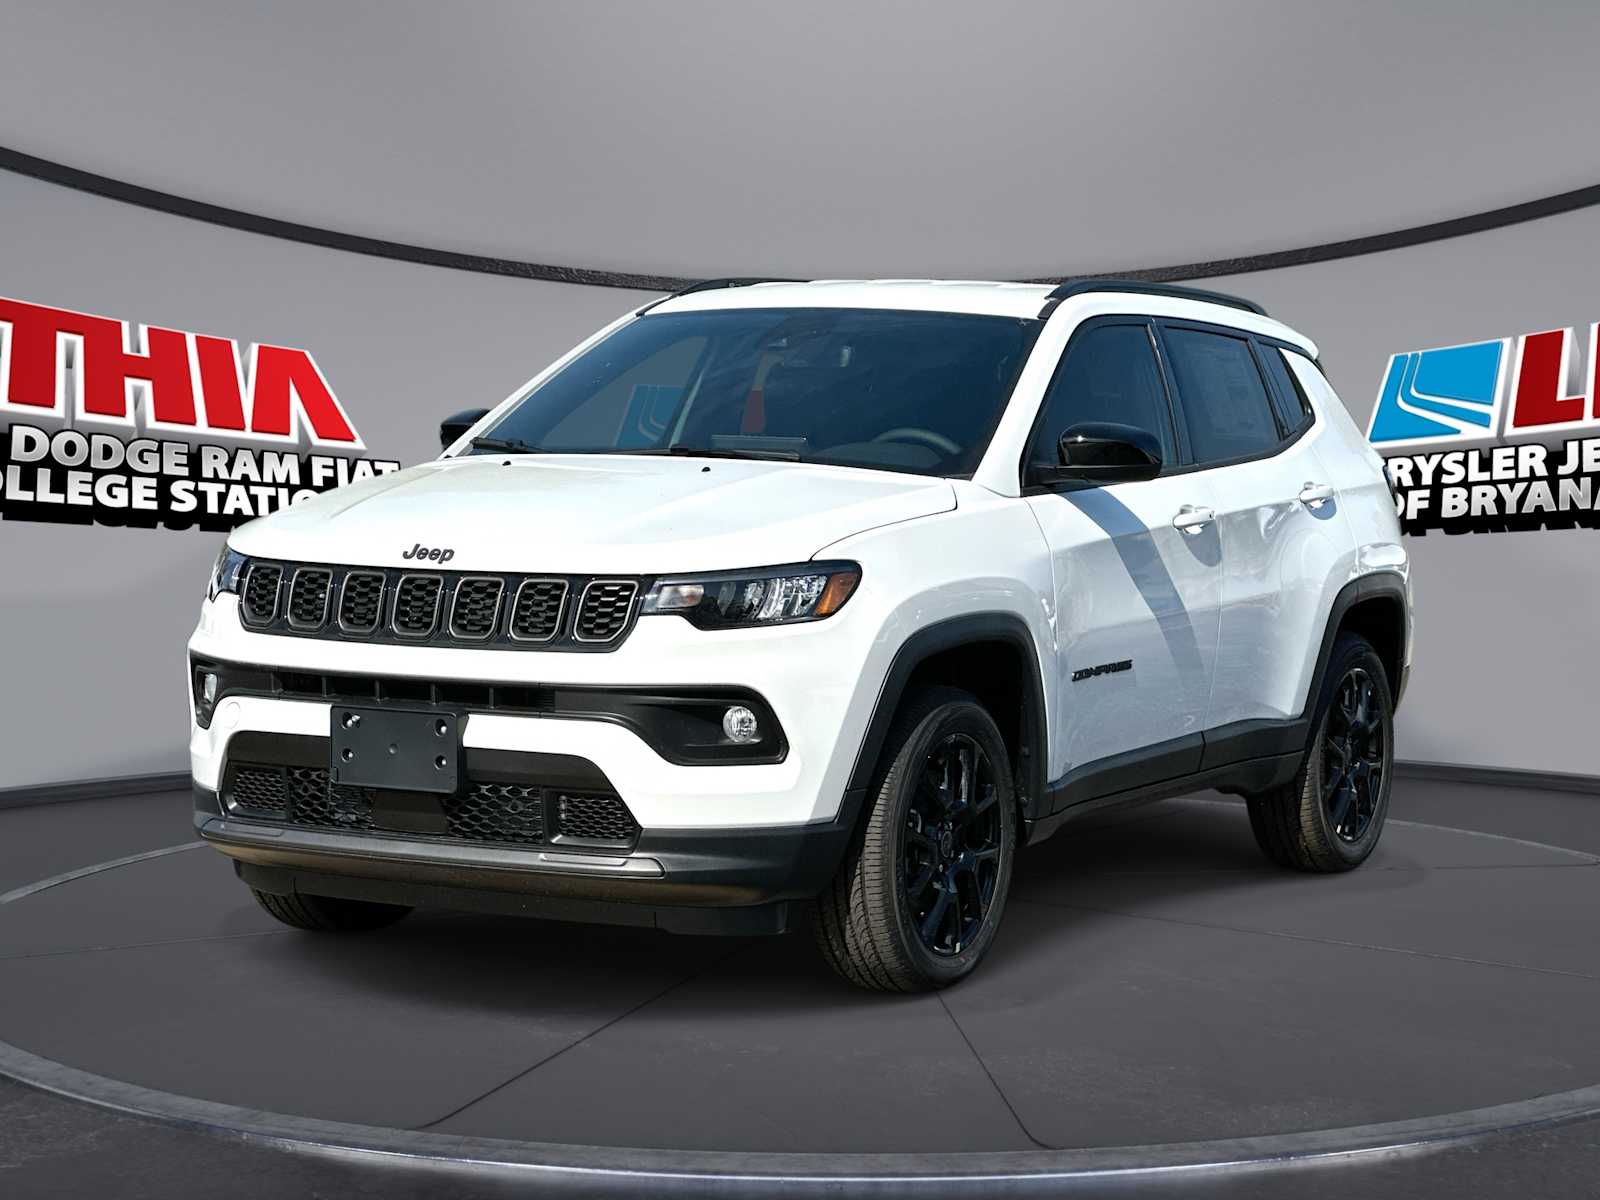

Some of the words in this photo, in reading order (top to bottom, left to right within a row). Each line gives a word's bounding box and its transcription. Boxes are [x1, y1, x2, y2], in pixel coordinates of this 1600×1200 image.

[0, 297, 367, 450] THIA
[1505, 322, 1600, 435] L
[10, 425, 189, 476] DODGE
[201, 446, 301, 485] RAM
[0, 465, 159, 510] LLEGE
[1440, 477, 1600, 518] BRYAN
[402, 543, 455, 565] Jeep
